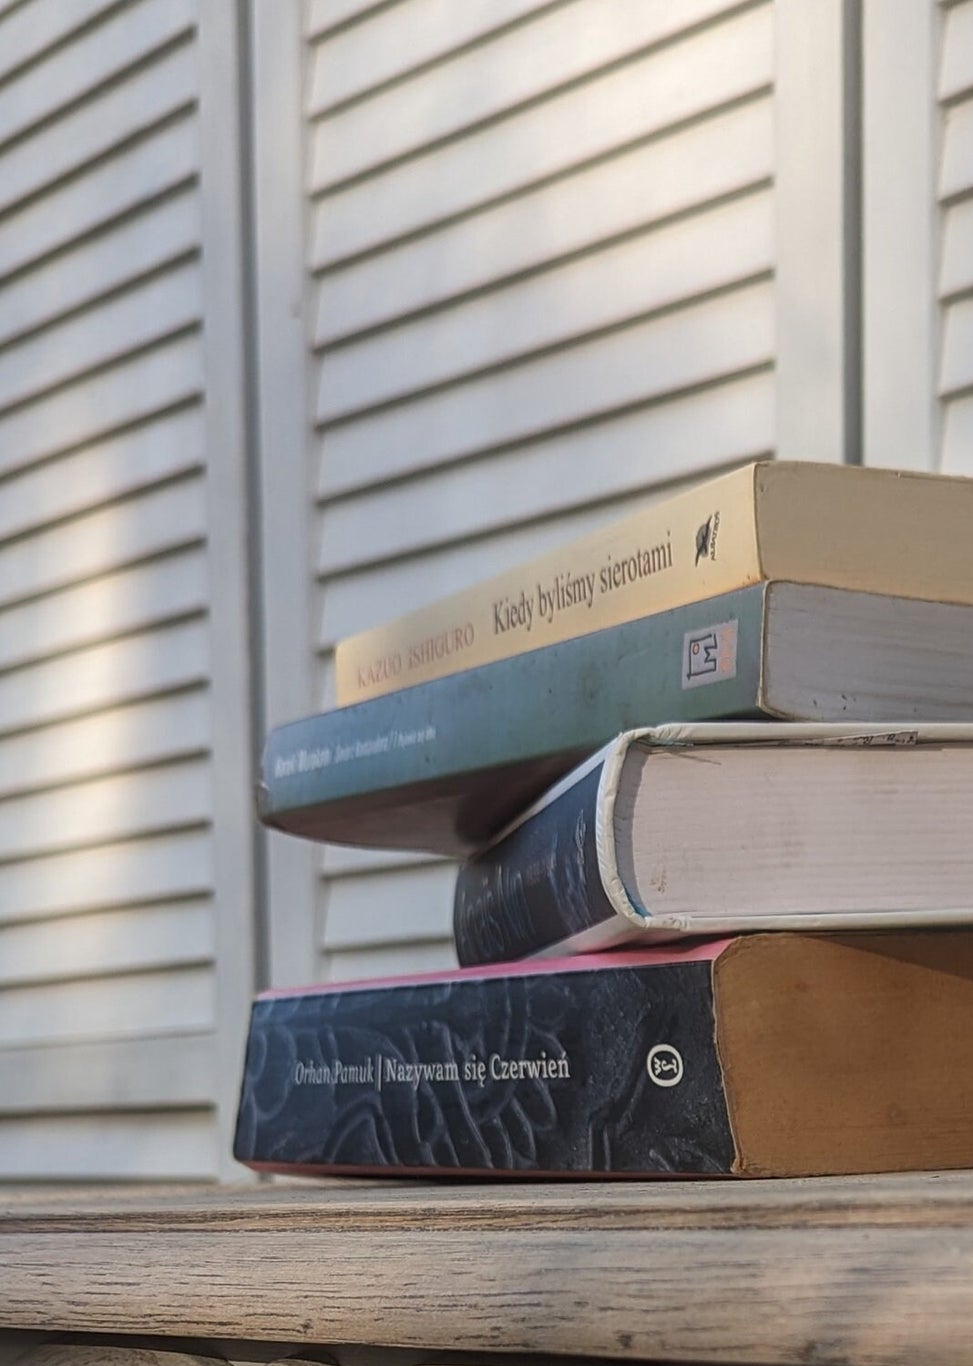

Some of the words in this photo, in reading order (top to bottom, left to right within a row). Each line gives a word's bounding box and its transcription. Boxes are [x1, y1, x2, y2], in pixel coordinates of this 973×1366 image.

[493, 592, 534, 636] Kiedy
[538, 571, 596, 622] byliśmy
[600, 530, 673, 593] sierotami
[358, 653, 402, 689] KAZUO
[407, 622, 474, 670] ISHIGURO
[295, 1058, 331, 1086] Orhan
[333, 1057, 375, 1086] Pamuk
[385, 1056, 460, 1091] Nazywam
[464, 1056, 486, 1088] się
[491, 1051, 571, 1081] Czerwień
